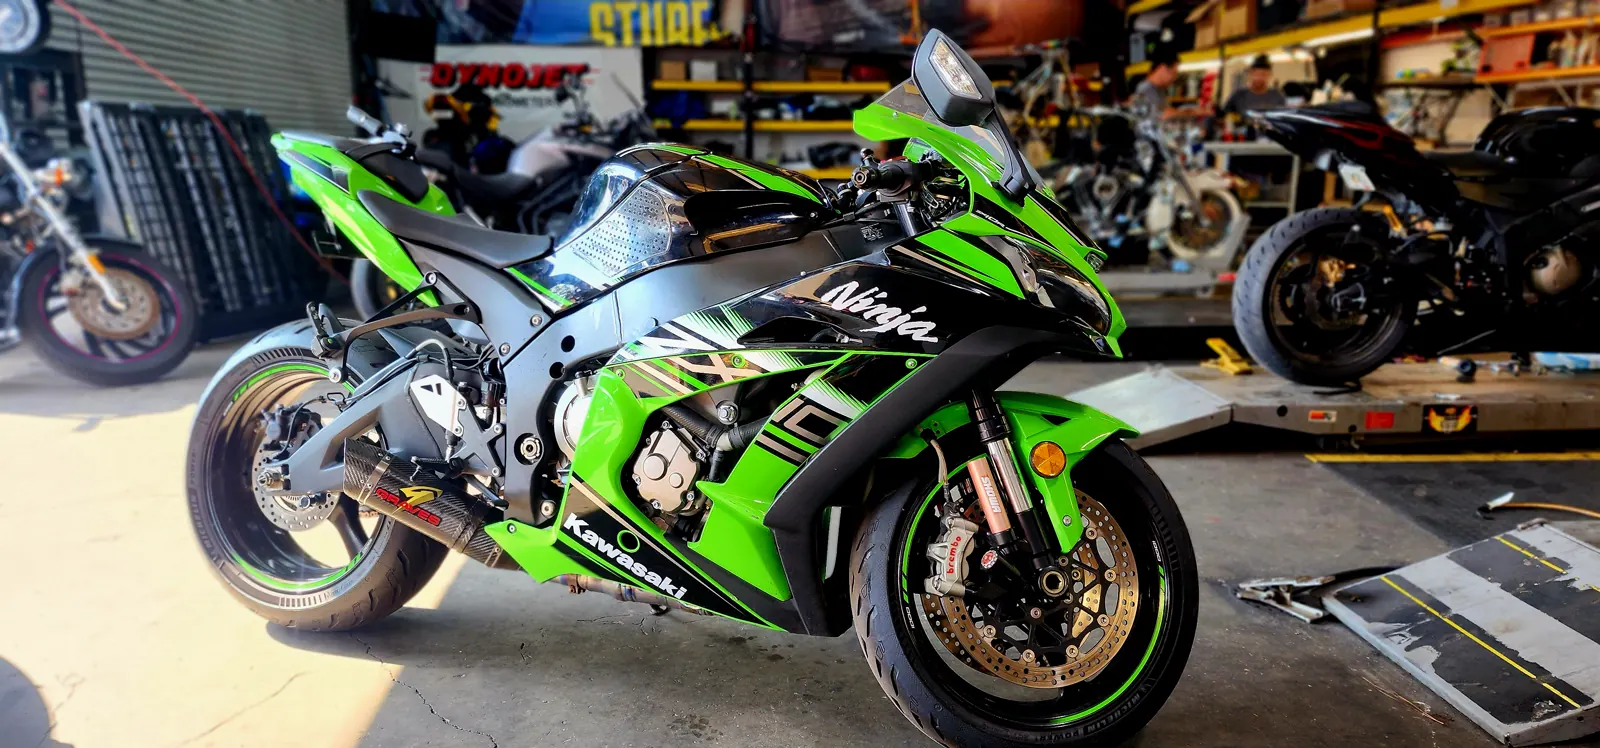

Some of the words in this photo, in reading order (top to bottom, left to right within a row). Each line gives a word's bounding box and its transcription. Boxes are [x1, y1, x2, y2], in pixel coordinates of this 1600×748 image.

[430, 62, 588, 88] DYNOJET
[820, 280, 939, 343] Ninja
[980, 475, 1001, 513] SHOWA
[563, 512, 688, 599] Kawasaki
[946, 536, 962, 574] brembo
